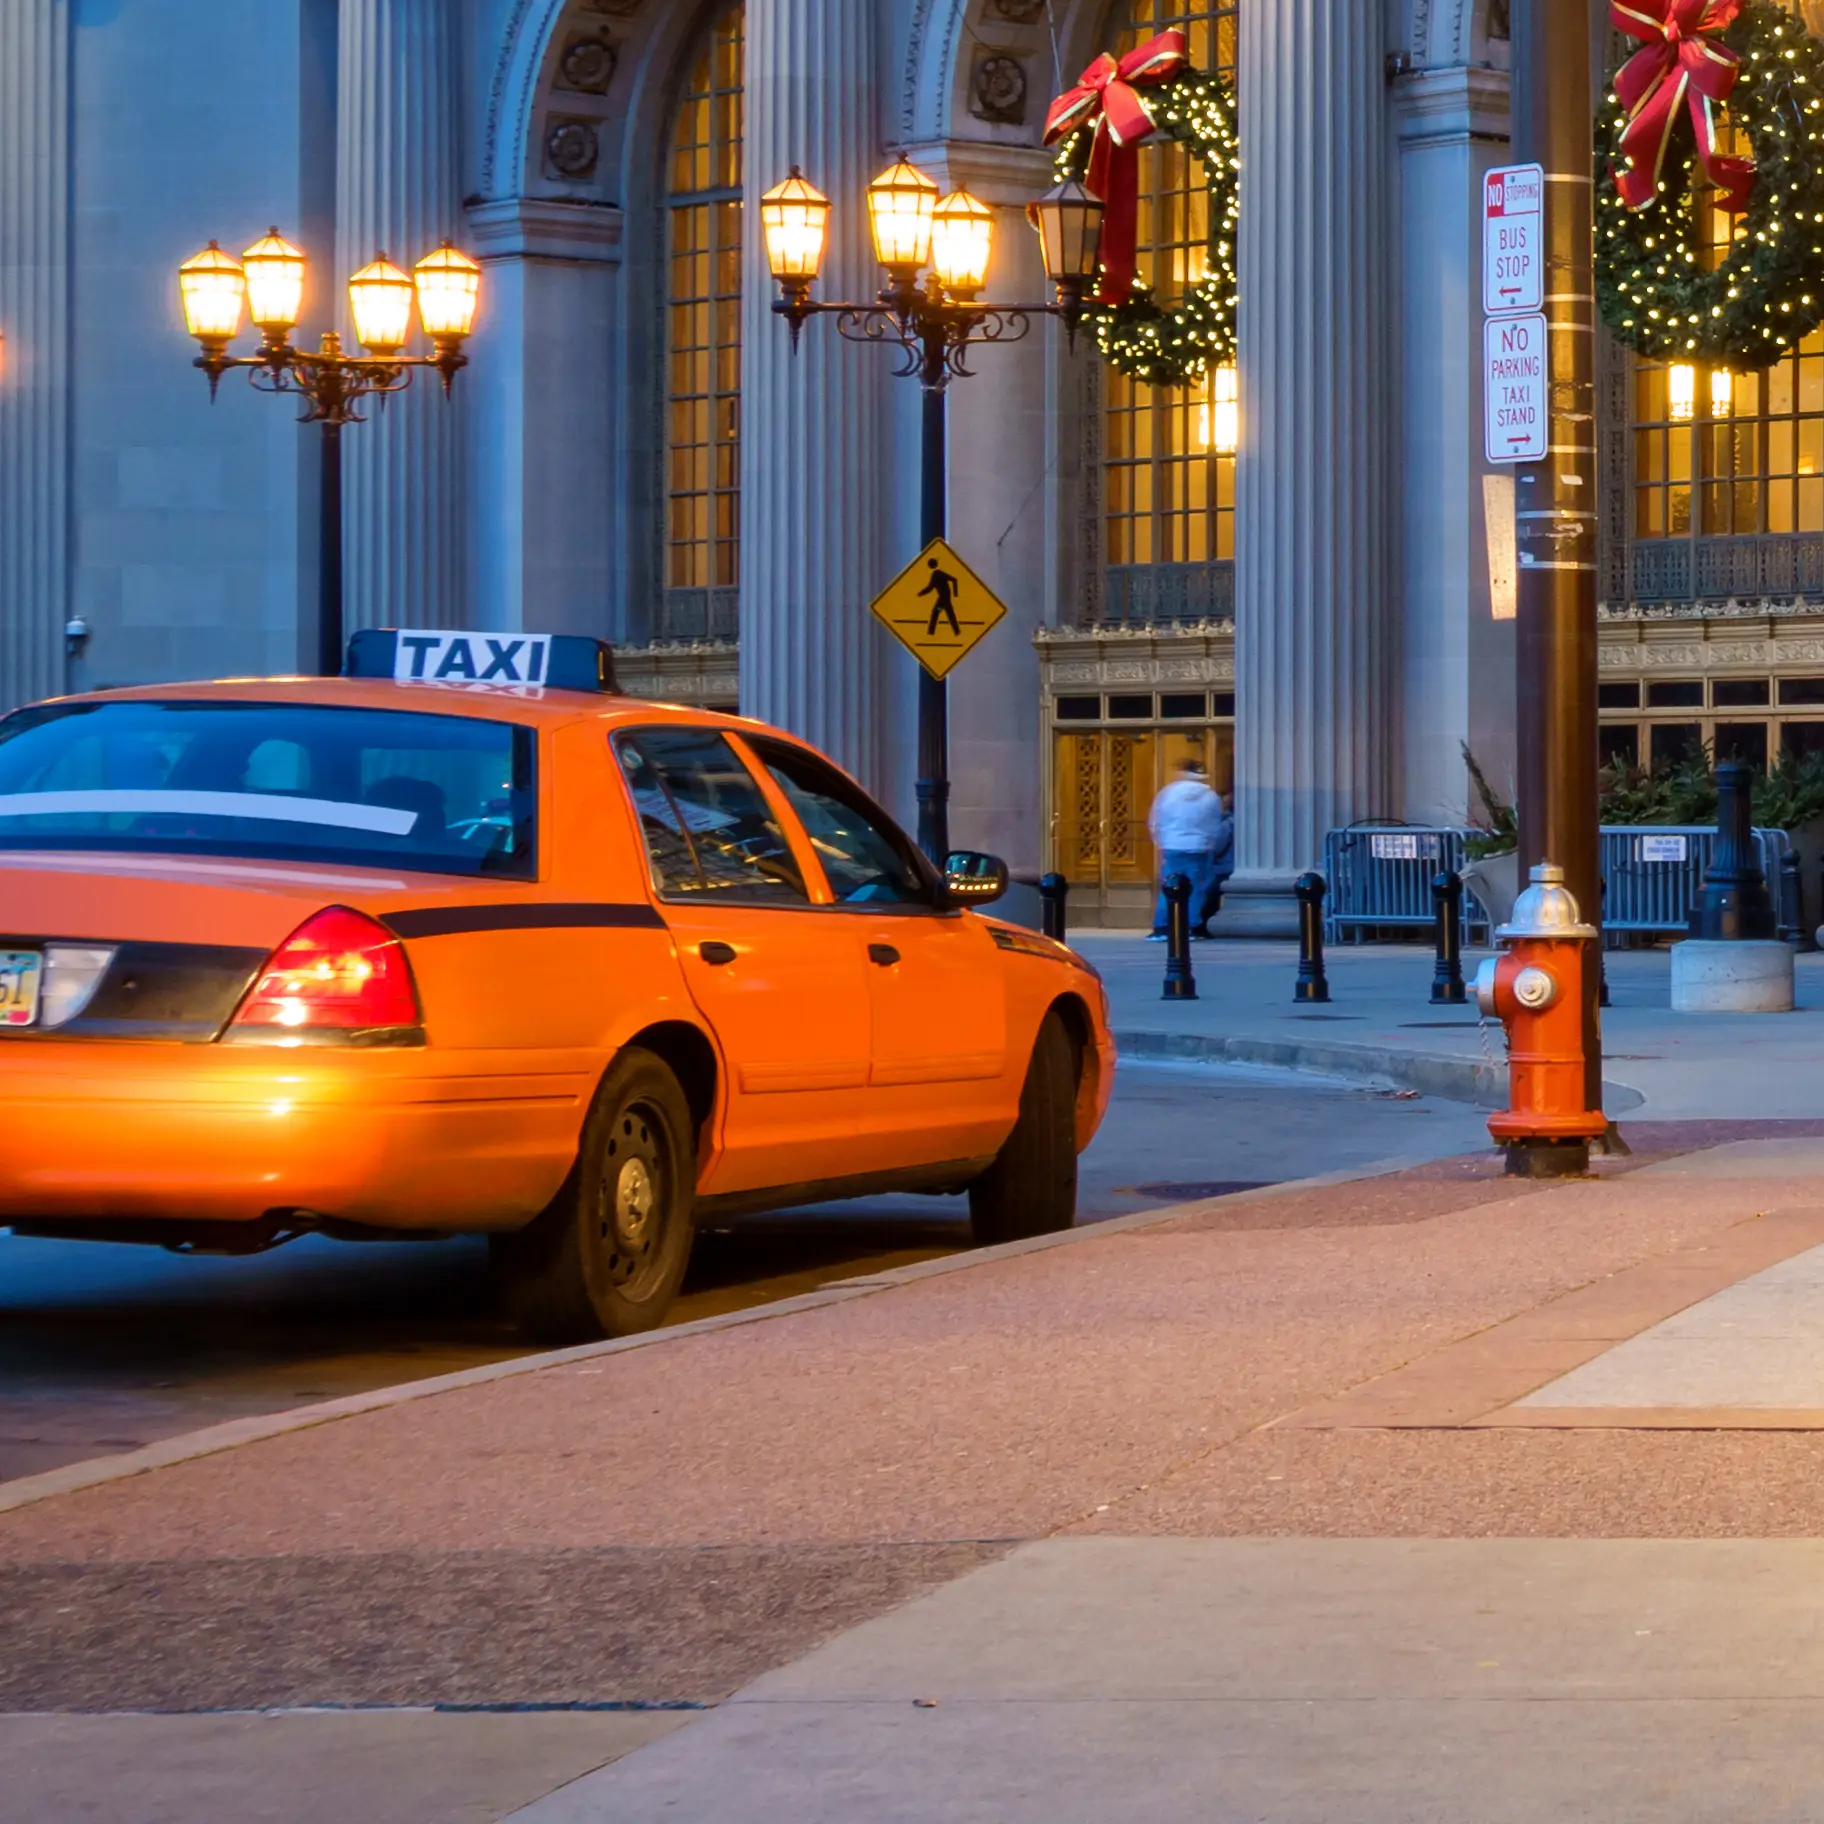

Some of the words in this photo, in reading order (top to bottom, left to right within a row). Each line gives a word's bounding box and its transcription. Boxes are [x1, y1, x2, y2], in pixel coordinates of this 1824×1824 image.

[1488, 183, 1503, 207] NO
[1505, 183, 1538, 201] STOPPING
[1499, 226, 1527, 250] BUS
[1496, 255, 1530, 279] STOP
[1502, 328, 1528, 353] NO
[1492, 356, 1539, 380] PARKING
[1502, 385, 1530, 404] TAXI
[1497, 407, 1536, 427] STAND
[402, 636, 544, 681] TAXI
